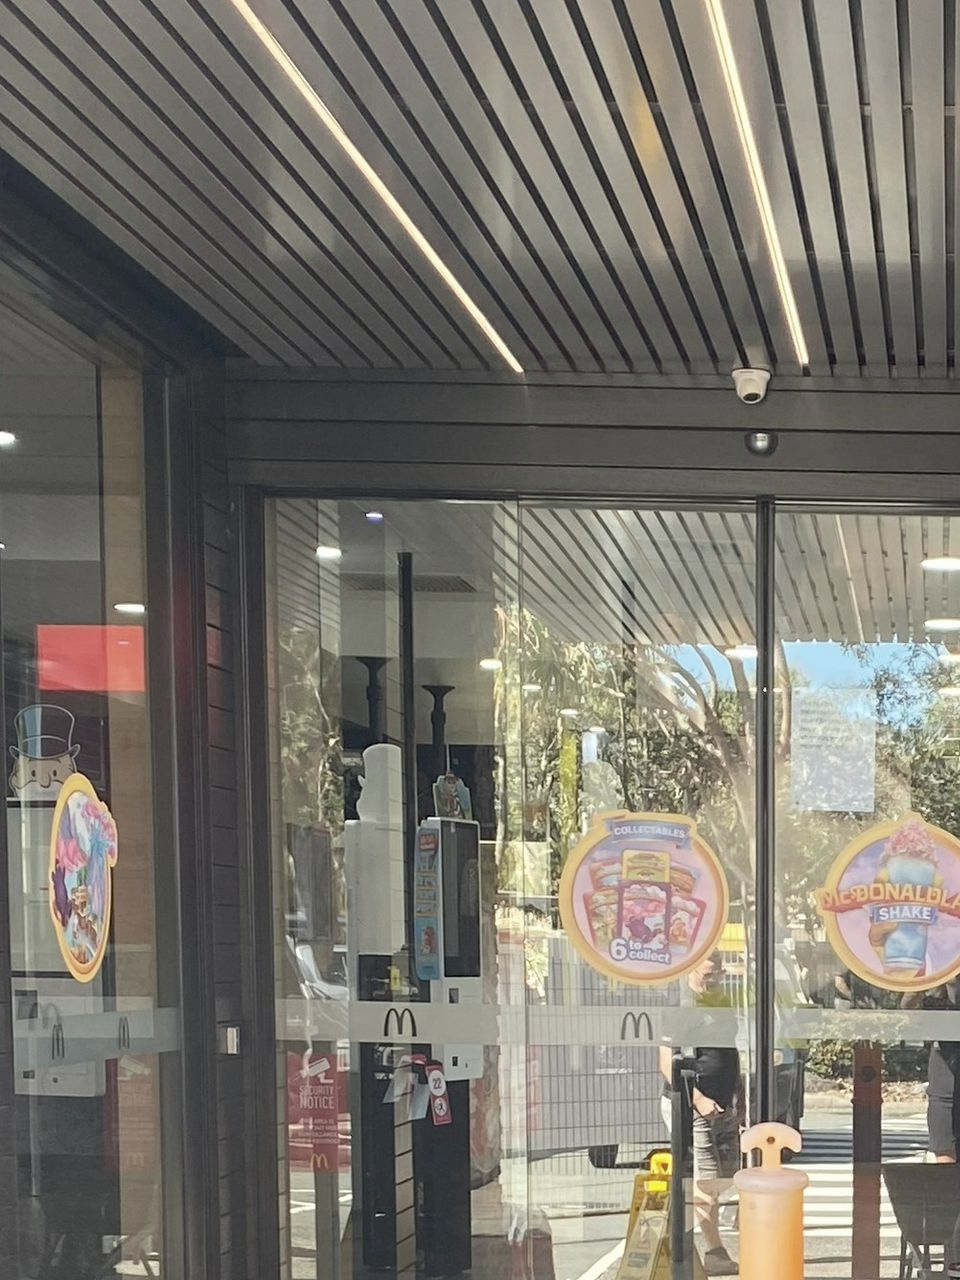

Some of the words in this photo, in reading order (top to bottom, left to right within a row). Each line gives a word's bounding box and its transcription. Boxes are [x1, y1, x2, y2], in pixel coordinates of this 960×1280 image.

[614, 825, 686, 839] COLLECTABLES
[879, 907, 932, 920] SHAKE
[610, 938, 627, 960] 6
[629, 939, 642, 950] to
[629, 950, 670, 963] collect
[299, 1085, 334, 1095] SECURITY
[432, 1078, 442, 1089] 22
[300, 1096, 335, 1109] NOTICE
